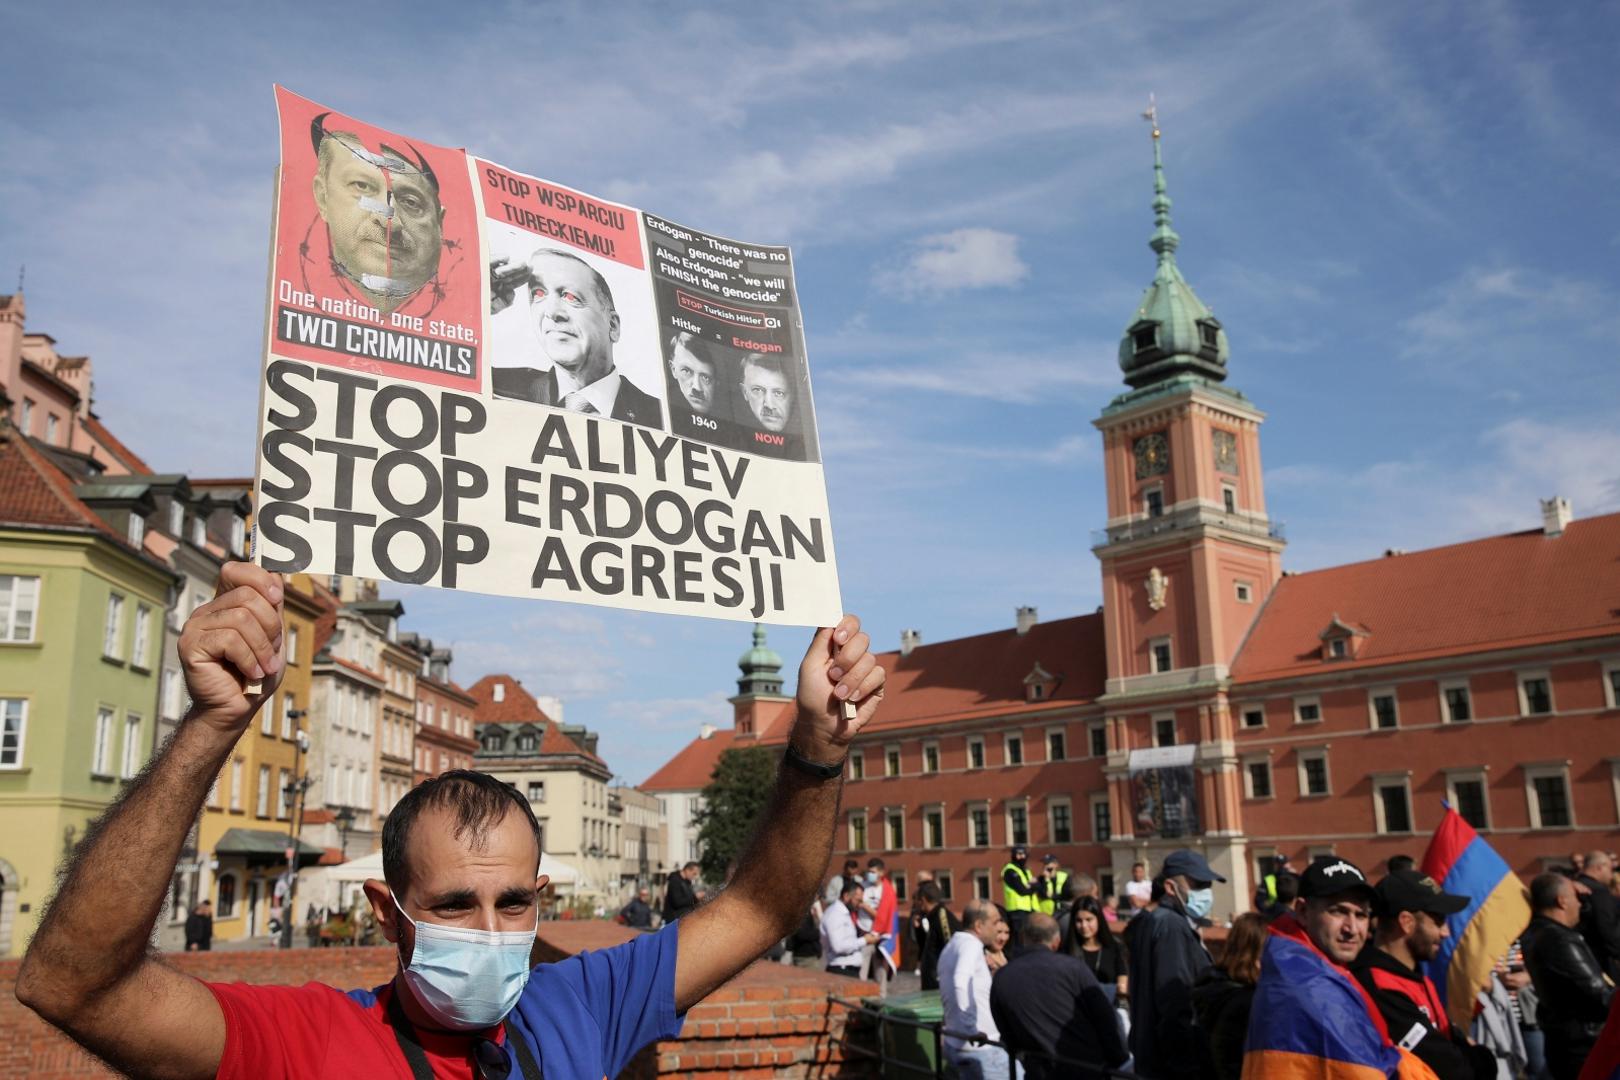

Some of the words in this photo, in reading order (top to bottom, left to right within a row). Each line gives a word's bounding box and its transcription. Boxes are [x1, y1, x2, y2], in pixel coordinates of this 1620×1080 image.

[486, 168, 530, 199] STOP
[536, 185, 625, 231] WSPARCIU
[502, 202, 616, 258] TURECKIEMU!
[646, 216, 693, 242] Erdogan
[702, 235, 742, 256] "There
[743, 248, 767, 260] was
[769, 252, 786, 262] no
[656, 246, 681, 265] Also
[681, 257, 729, 281] Erdogan
[763, 278, 786, 290] will
[688, 247, 744, 270] genocide"
[660, 262, 700, 286] FINISH
[701, 277, 720, 293] the
[722, 286, 781, 303] genocide"
[278, 279, 315, 309] One
[321, 296, 386, 326] nation,
[391, 311, 424, 332] one
[429, 320, 479, 345] state,
[671, 315, 702, 334] Hitler
[681, 296, 703, 310] STOP
[703, 304, 736, 321] Turkish
[736, 313, 763, 326] Hitler
[283, 309, 338, 348] TWO
[345, 324, 473, 376] CRIMINALS
[732, 336, 784, 354] Erdogan
[265, 359, 487, 457] STOP
[530, 413, 750, 500] ALIYEV
[690, 413, 719, 432] 1940
[754, 430, 785, 447] NOW
[260, 428, 489, 523] STOP
[504, 465, 827, 563] ERDOGAN
[257, 500, 491, 589] STOP
[530, 535, 785, 619] AGRESJI
